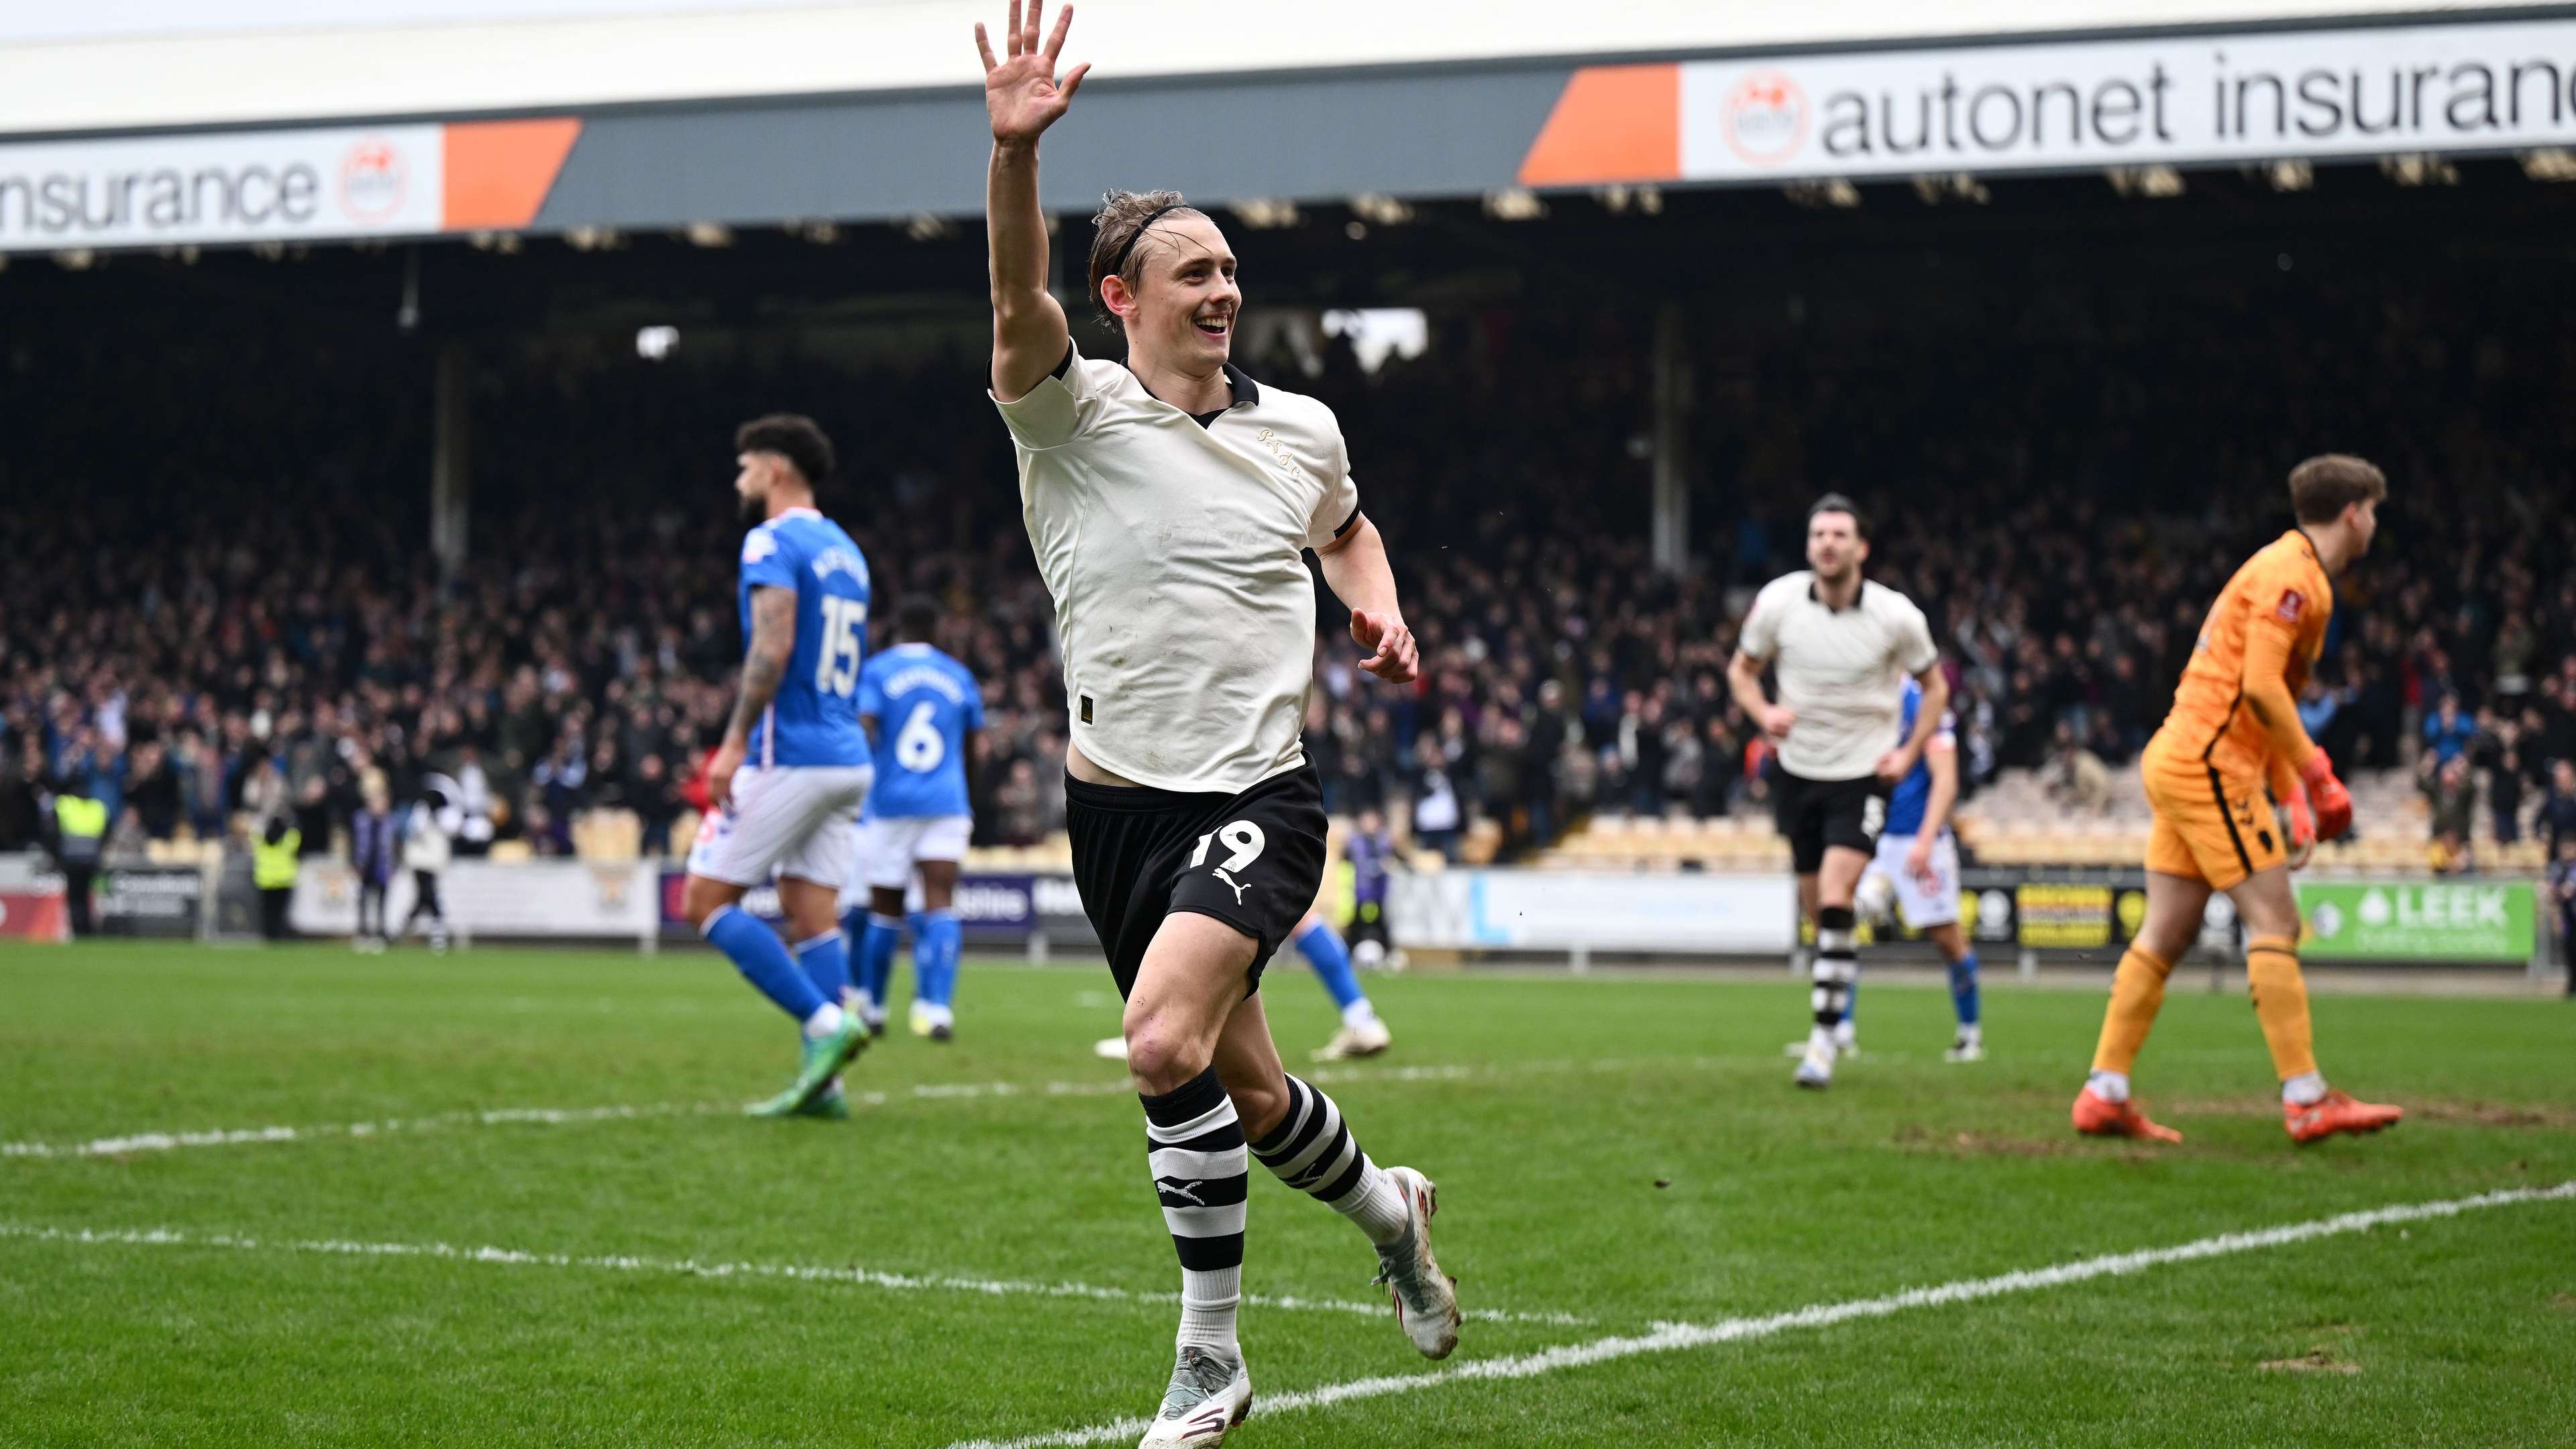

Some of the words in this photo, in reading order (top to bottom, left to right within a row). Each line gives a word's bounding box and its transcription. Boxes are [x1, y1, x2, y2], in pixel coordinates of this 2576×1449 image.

[1821, 63, 2172, 156] autonet
[2214, 51, 2576, 138] insuran
[0, 162, 317, 233] nsurance
[816, 596, 866, 698] 15
[896, 701, 945, 773] 6
[1190, 820, 1265, 873] 19
[2397, 882, 2508, 927] LEEK
